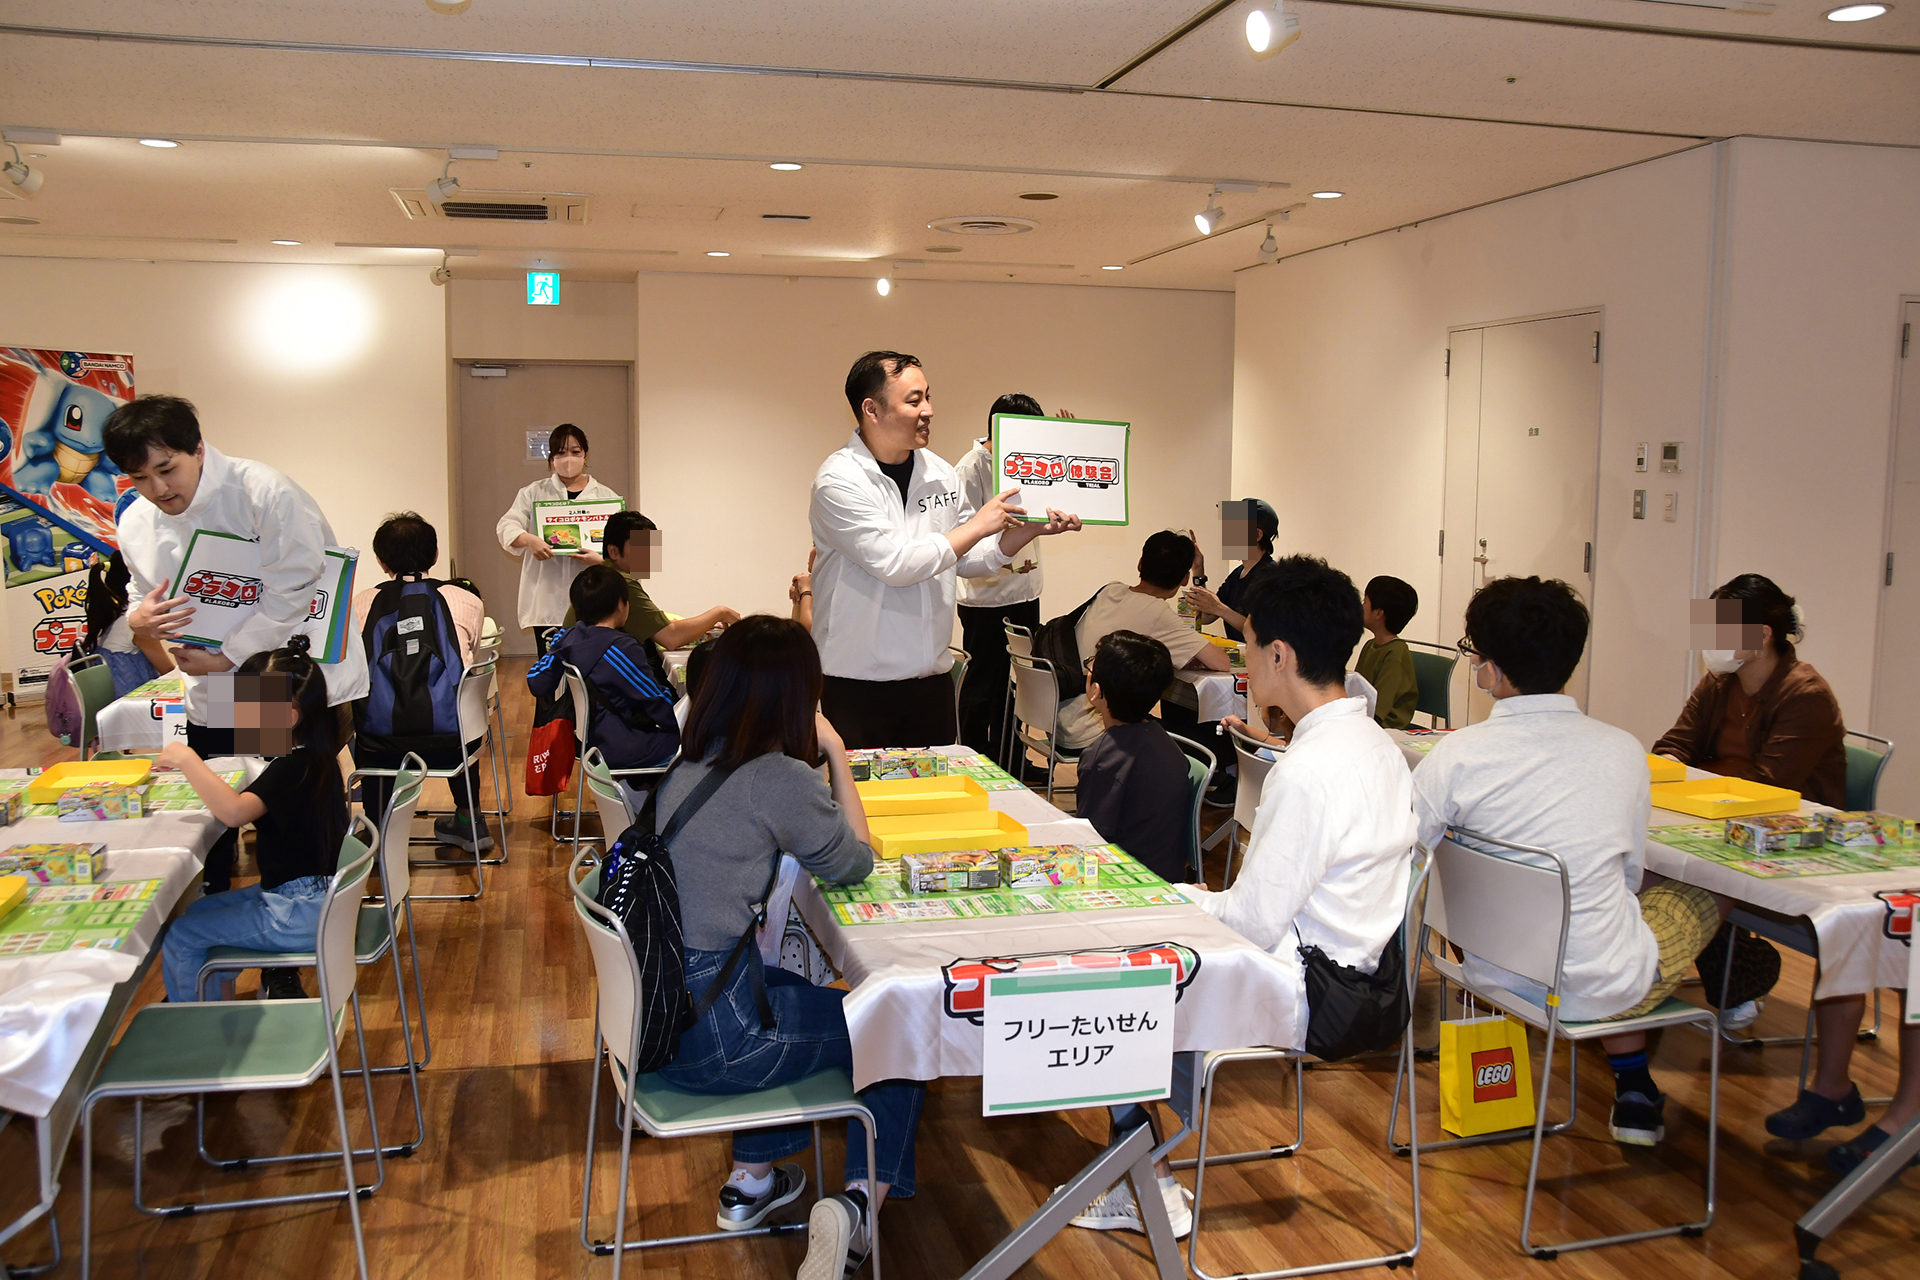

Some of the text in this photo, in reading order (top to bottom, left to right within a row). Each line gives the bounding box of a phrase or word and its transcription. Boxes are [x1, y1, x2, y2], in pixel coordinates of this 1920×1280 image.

[917, 491, 957, 513] STAFF
[33, 579, 88, 614] Poké
[1004, 1011, 1158, 1041] フリーたいせん
[1047, 1045, 1114, 1068] エリア
[1477, 1063, 1512, 1087] LEGO
